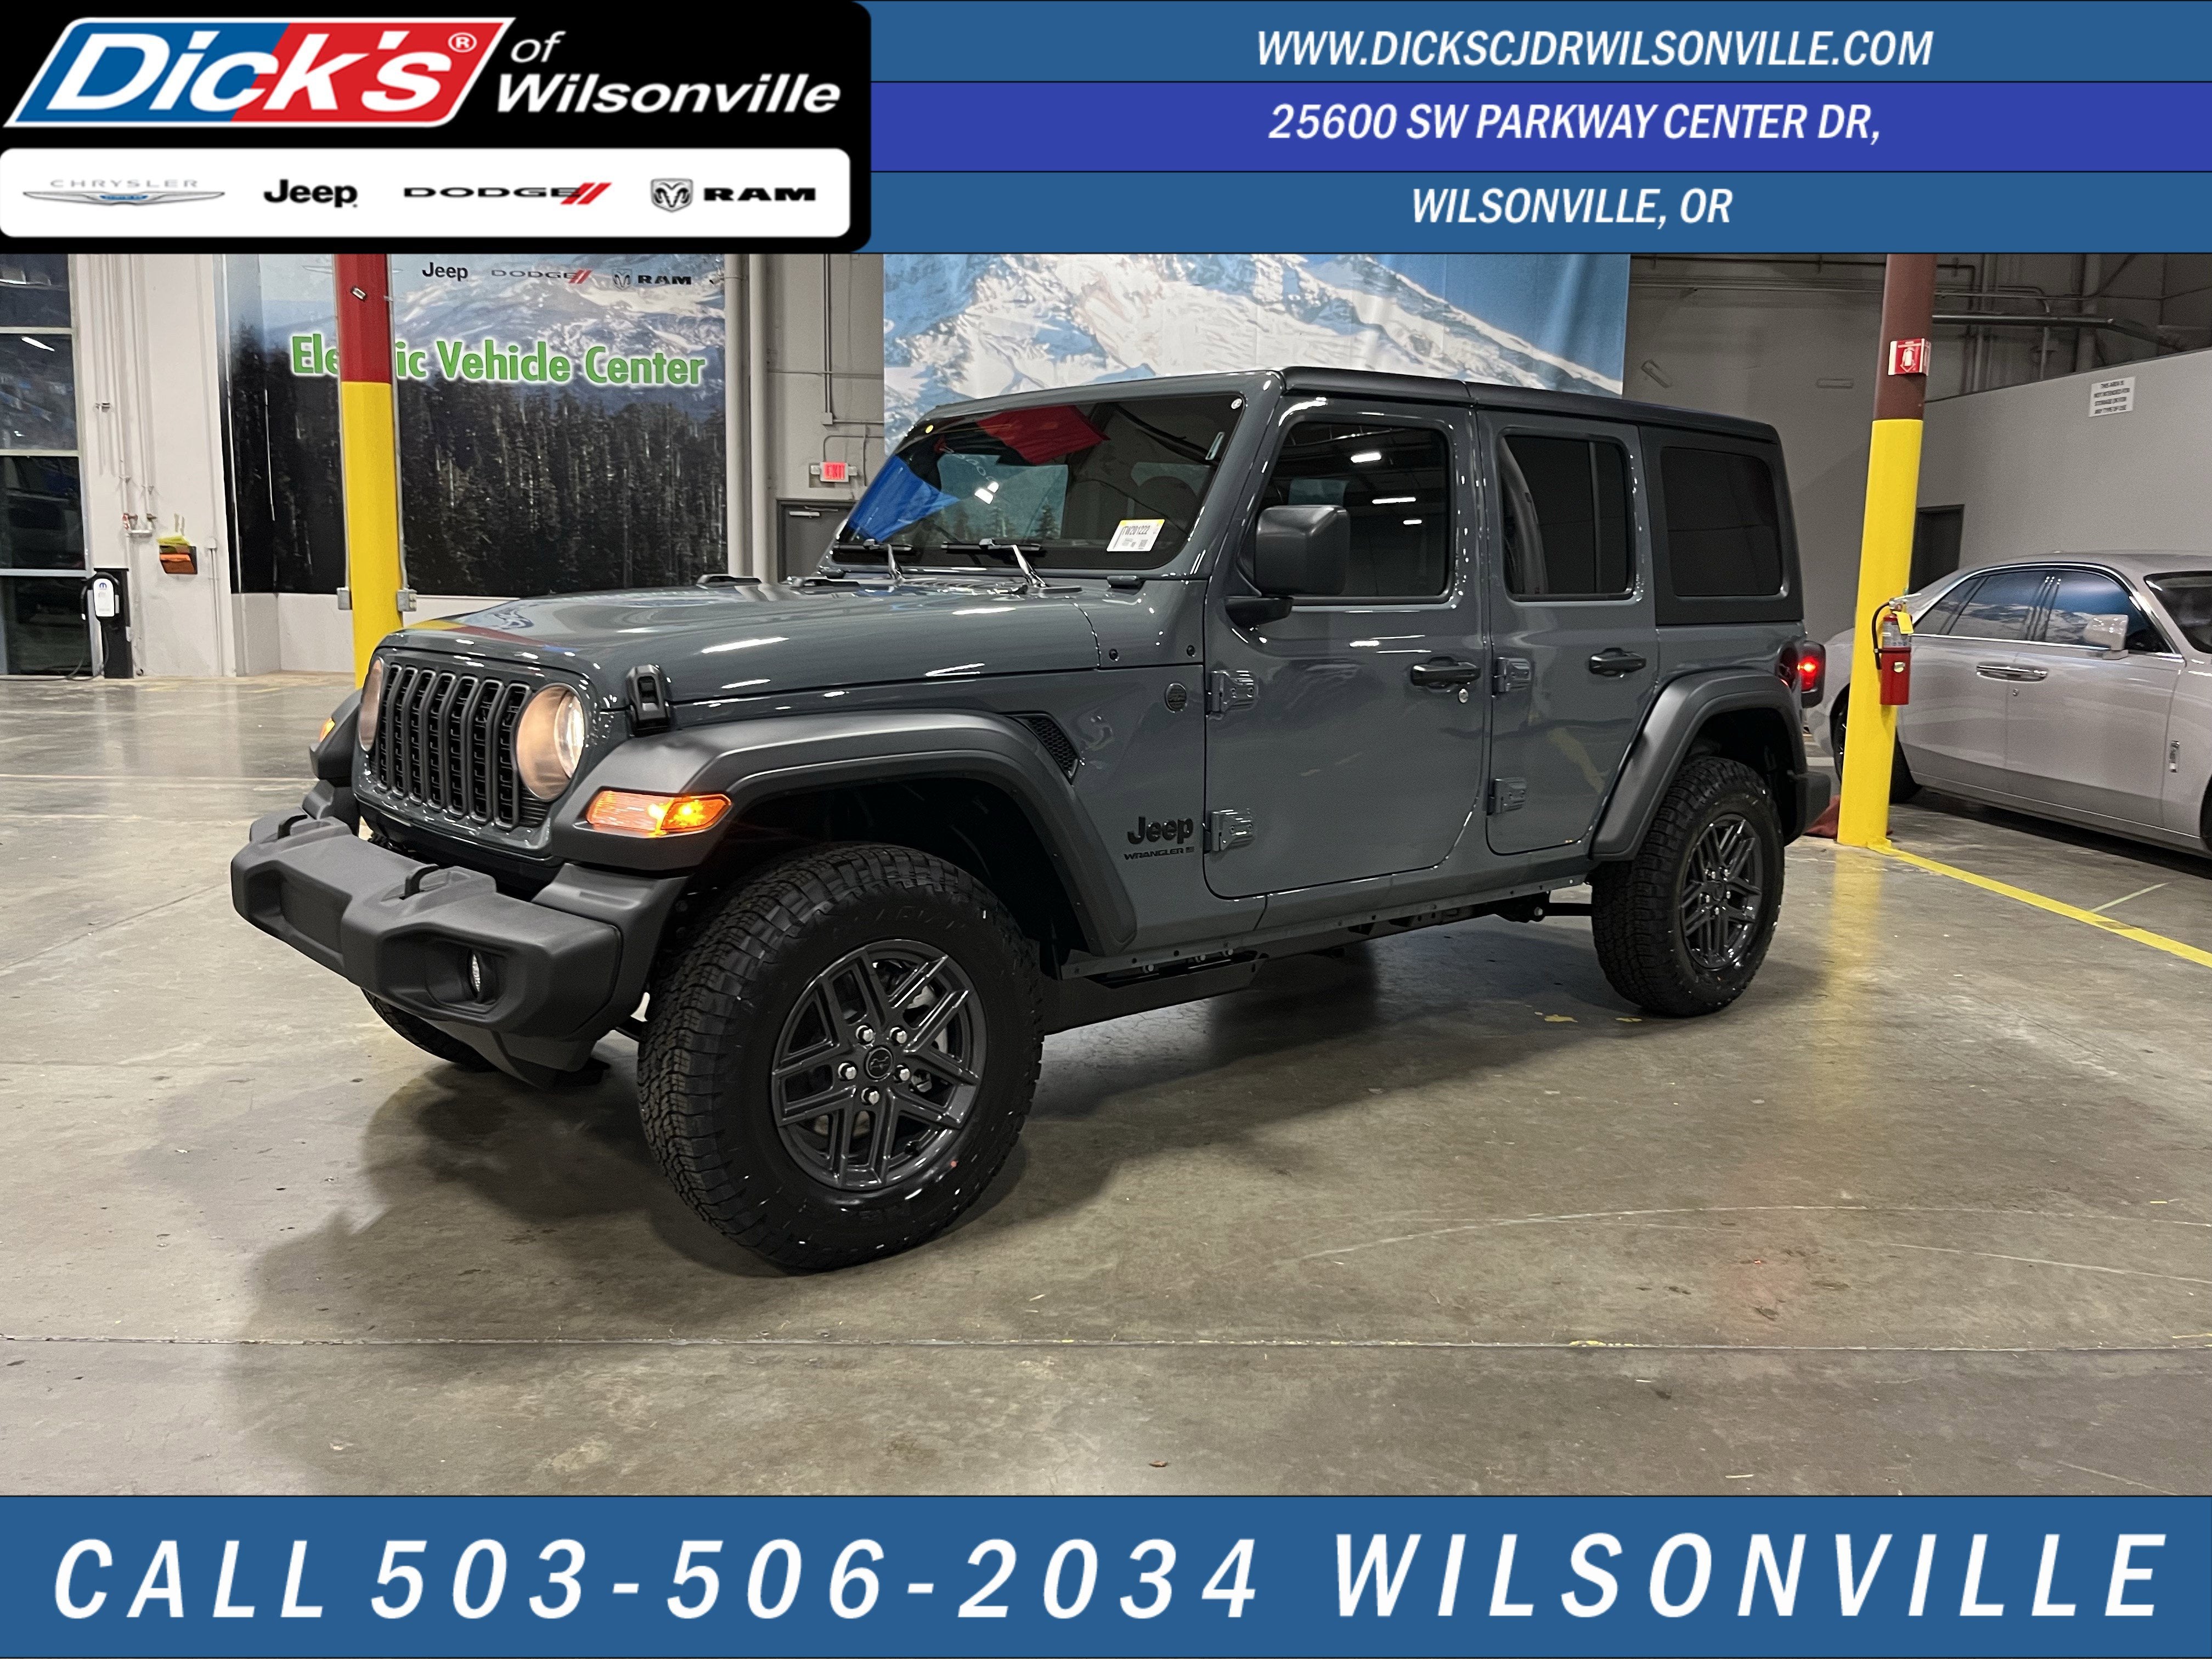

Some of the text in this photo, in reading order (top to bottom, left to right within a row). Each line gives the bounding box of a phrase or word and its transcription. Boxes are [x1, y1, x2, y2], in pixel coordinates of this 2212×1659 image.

[422, 262, 469, 281] Jeep
[491, 269, 579, 279] DODGE
[637, 275, 692, 285] RAM
[292, 333, 706, 385] Eleic Vehicle Center
[826, 464, 845, 479] EXIT
[1127, 815, 1194, 844] Jeep
[1124, 848, 1184, 860] WRANGLER
